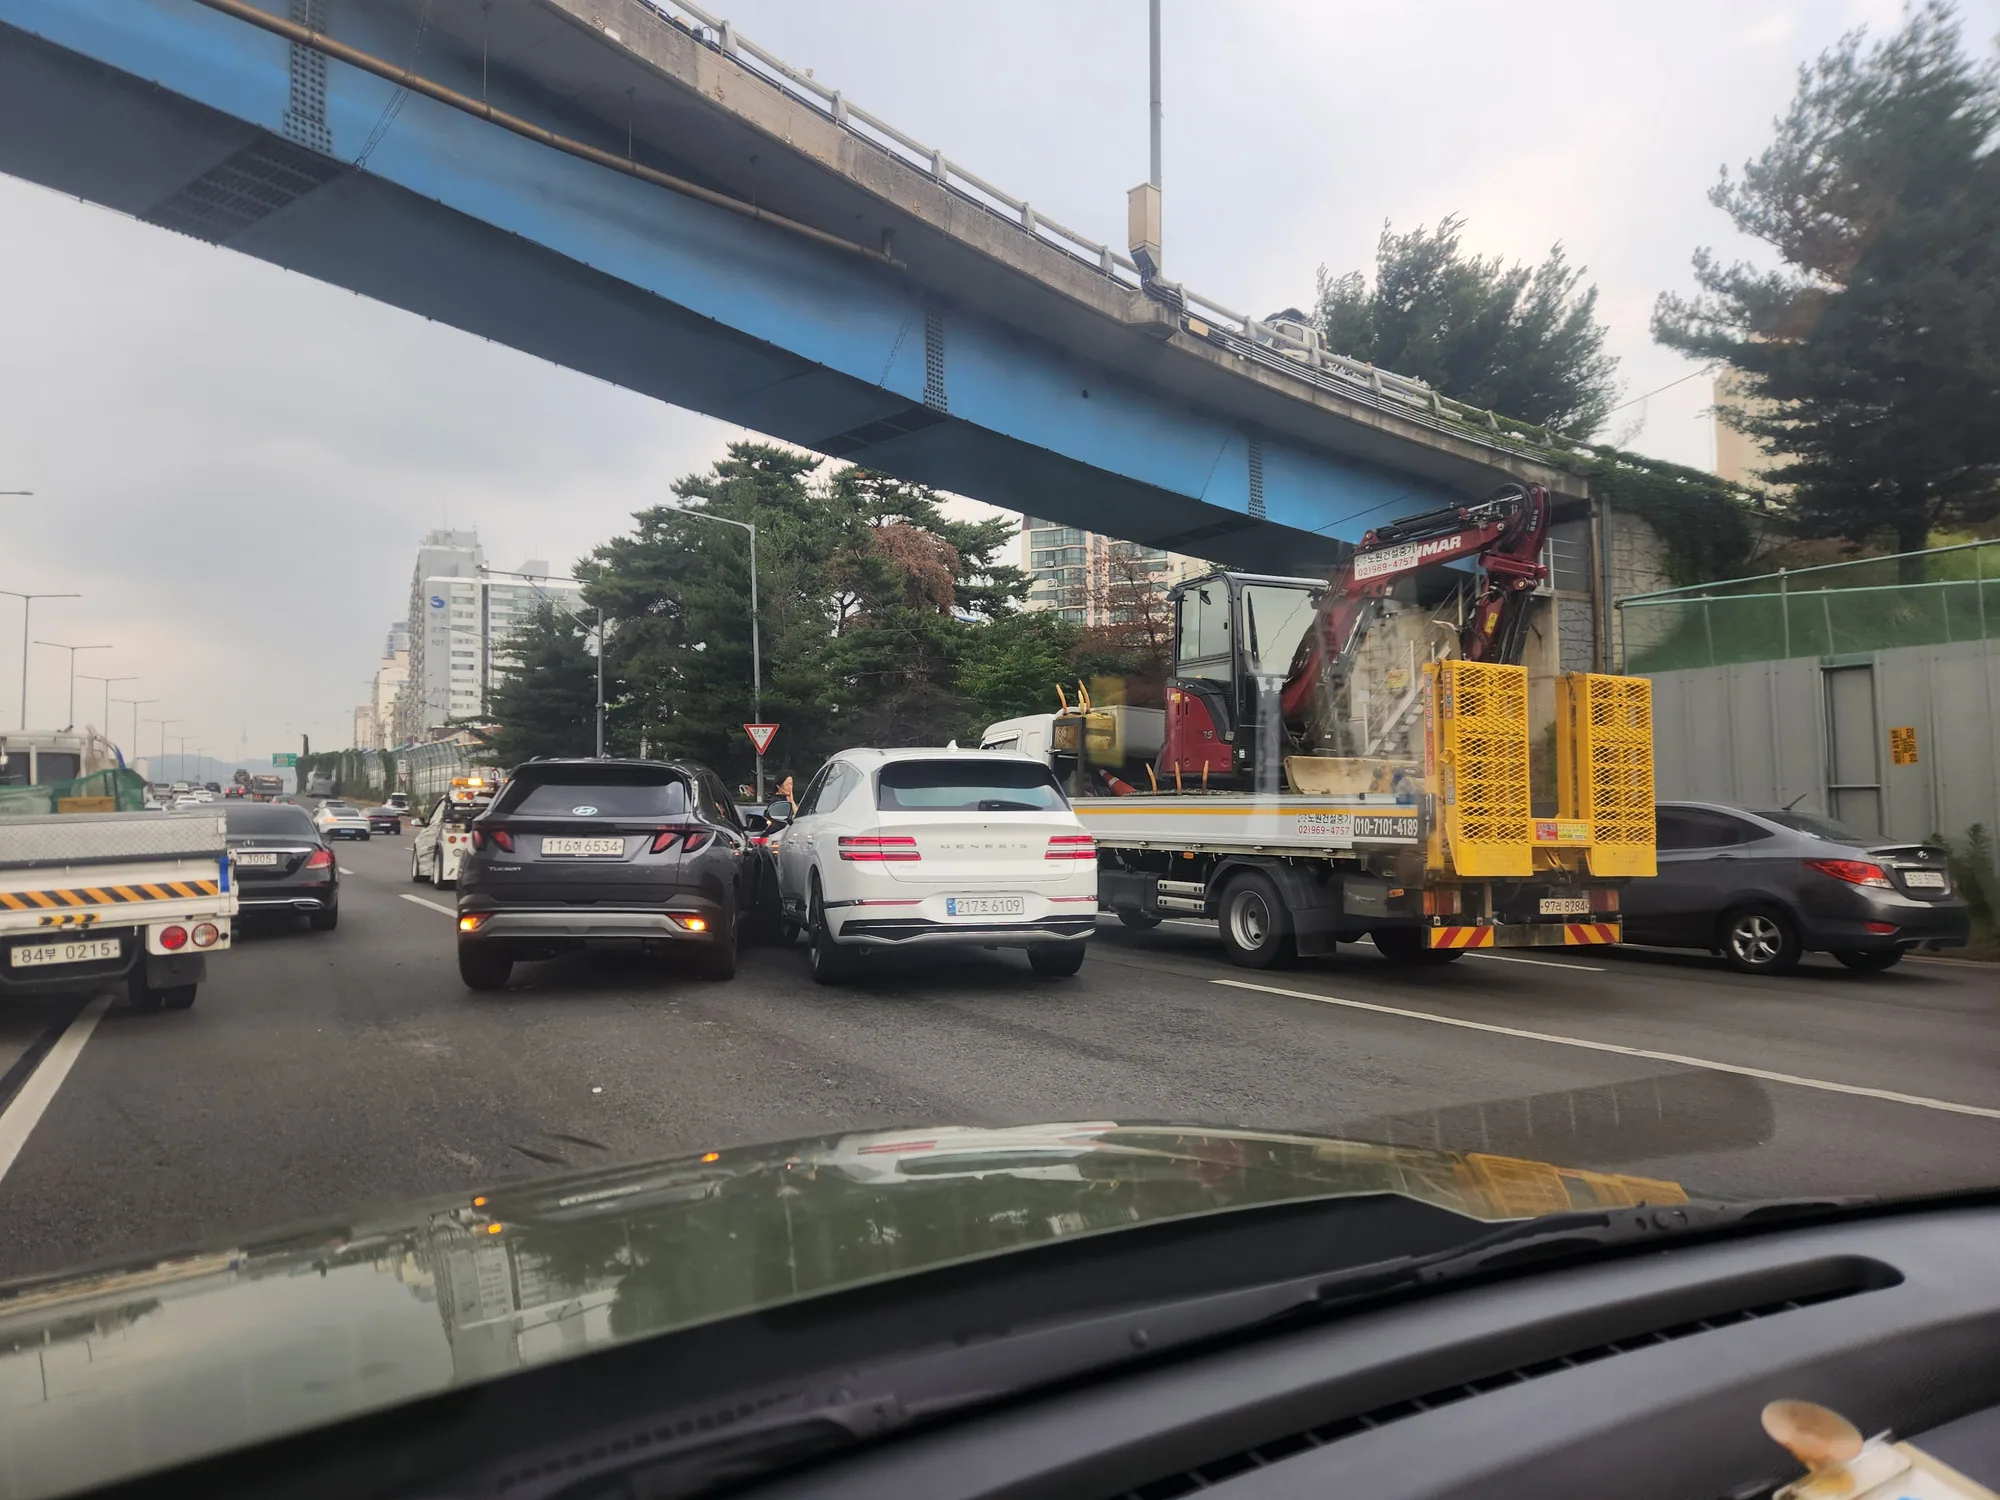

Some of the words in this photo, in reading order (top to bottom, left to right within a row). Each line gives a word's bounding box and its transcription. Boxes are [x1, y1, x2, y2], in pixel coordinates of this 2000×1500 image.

[1358, 557, 1414, 576] 02)969-4757
[1298, 825, 1350, 835] 02)969-4757
[1355, 818, 1418, 836] 010-7101-4189
[584, 841, 618, 852] 6534
[248, 855, 271, 864] 3005
[957, 900, 989, 913] 217조
[991, 900, 1020, 912] 6109
[1565, 901, 1585, 912] 8284
[21, 948, 56, 964] 84부
[65, 943, 110, 960] 0215
